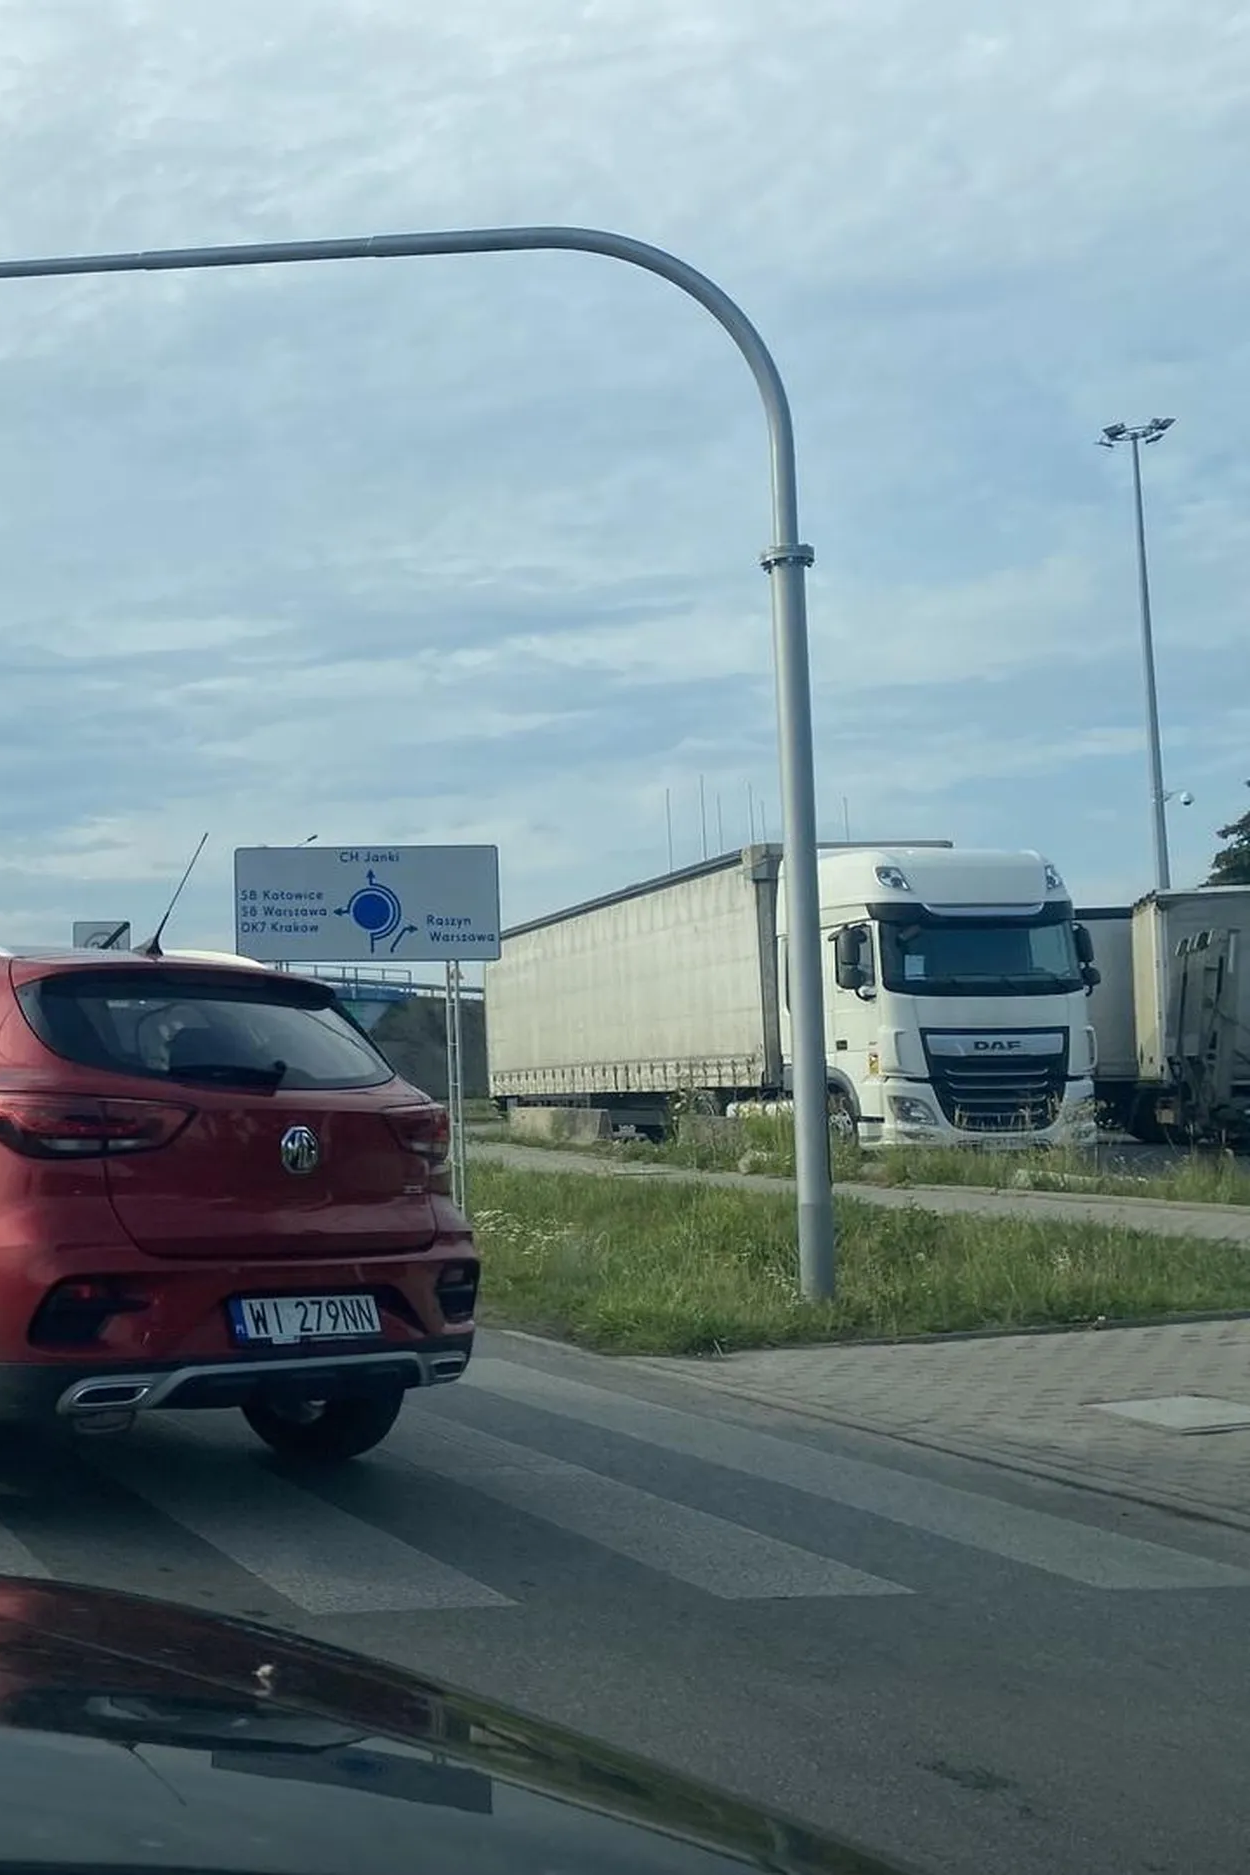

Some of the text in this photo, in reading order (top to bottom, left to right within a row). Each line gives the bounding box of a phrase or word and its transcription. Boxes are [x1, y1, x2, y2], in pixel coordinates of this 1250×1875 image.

[340, 852, 400, 863] CH Janki
[263, 890, 324, 901] Katowice
[262, 905, 328, 917] Warszawa
[241, 921, 267, 933] DK7
[426, 914, 472, 929] Raszyn
[429, 930, 496, 943] Warszawa
[973, 1040, 1022, 1051] DAF
[249, 1299, 376, 1335] WI 279NN
